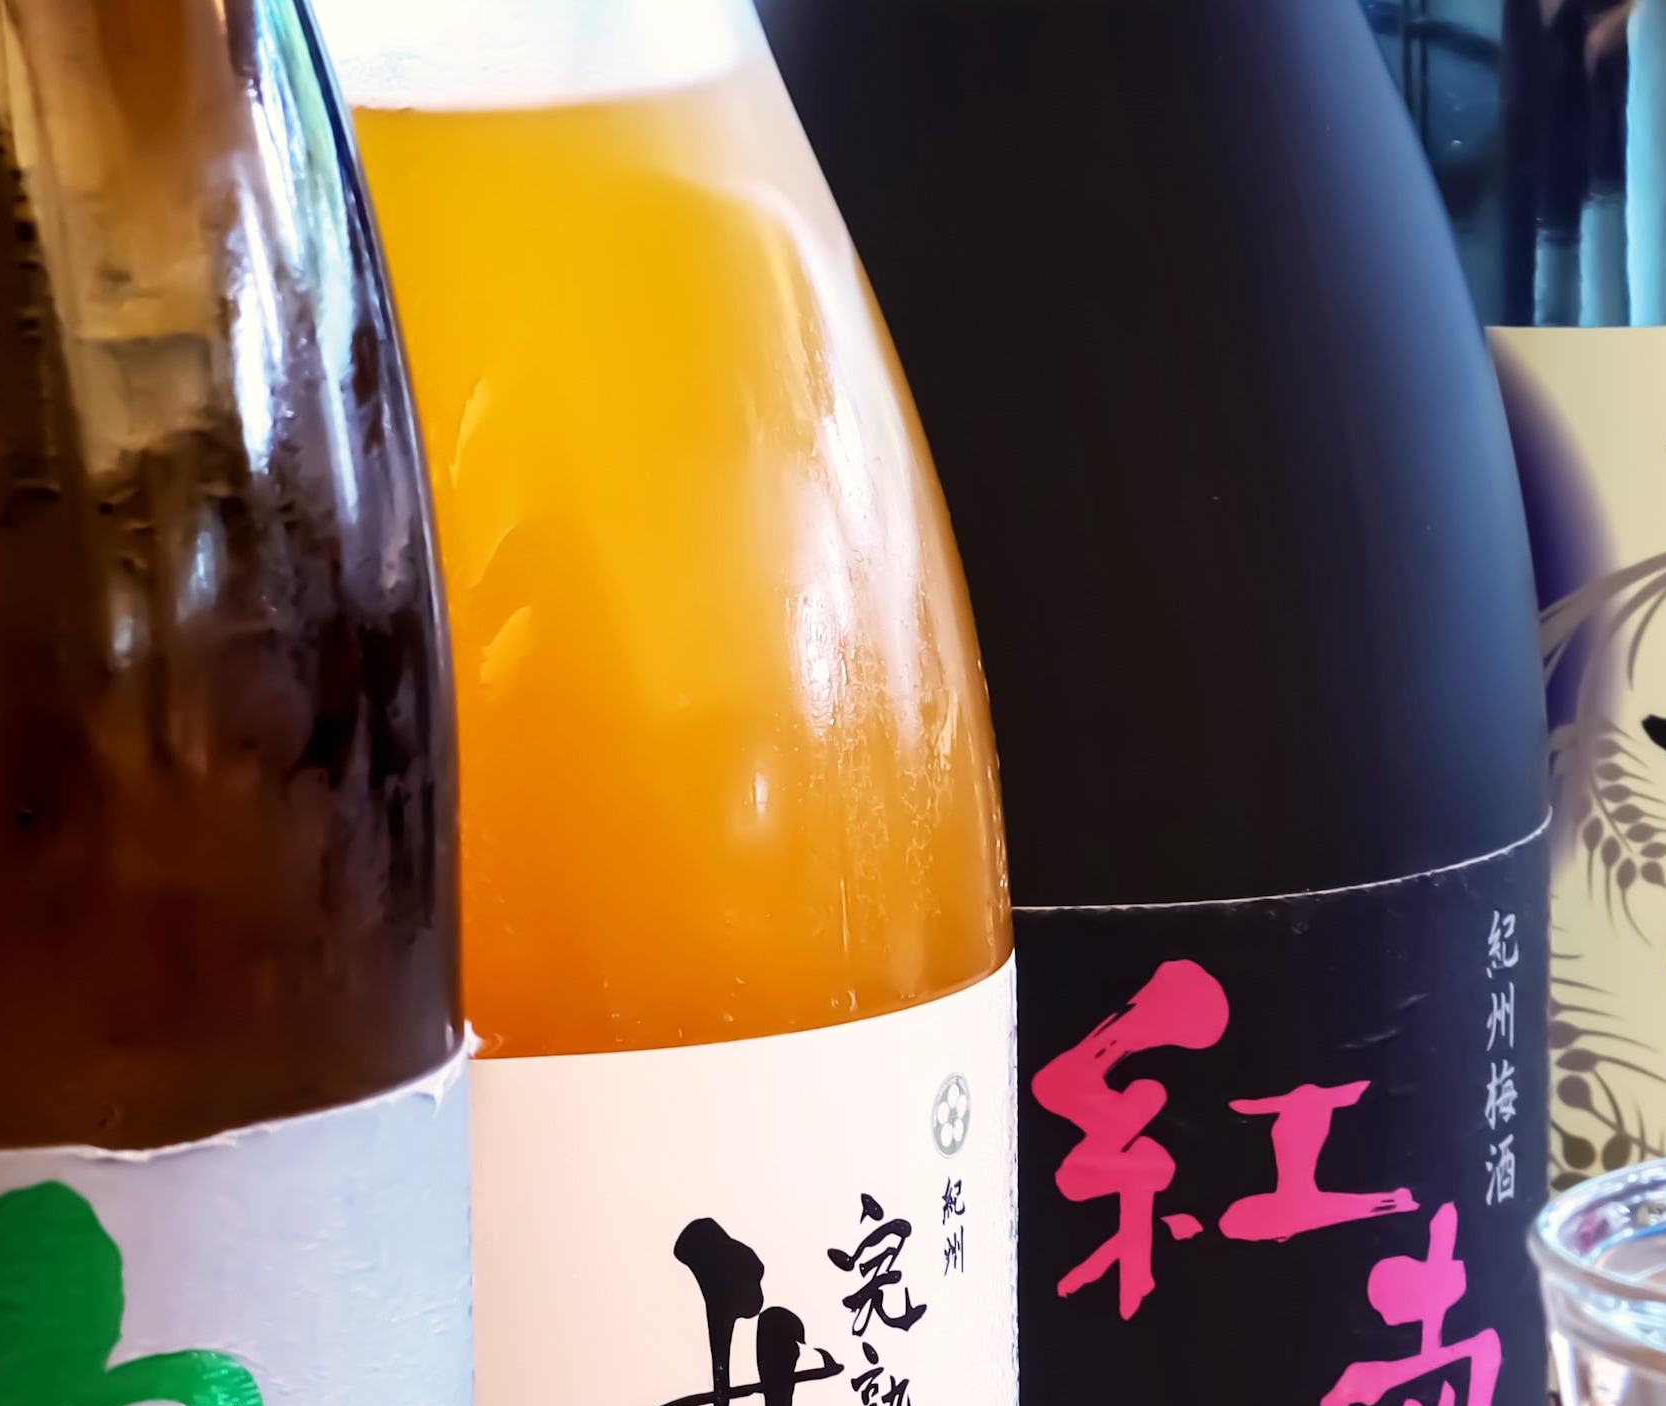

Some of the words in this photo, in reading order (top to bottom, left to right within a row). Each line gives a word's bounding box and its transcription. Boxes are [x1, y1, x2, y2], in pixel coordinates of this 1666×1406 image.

[1485, 911, 1519, 1206] 紀州梅酒
[941, 1176, 966, 1277] 紀州
